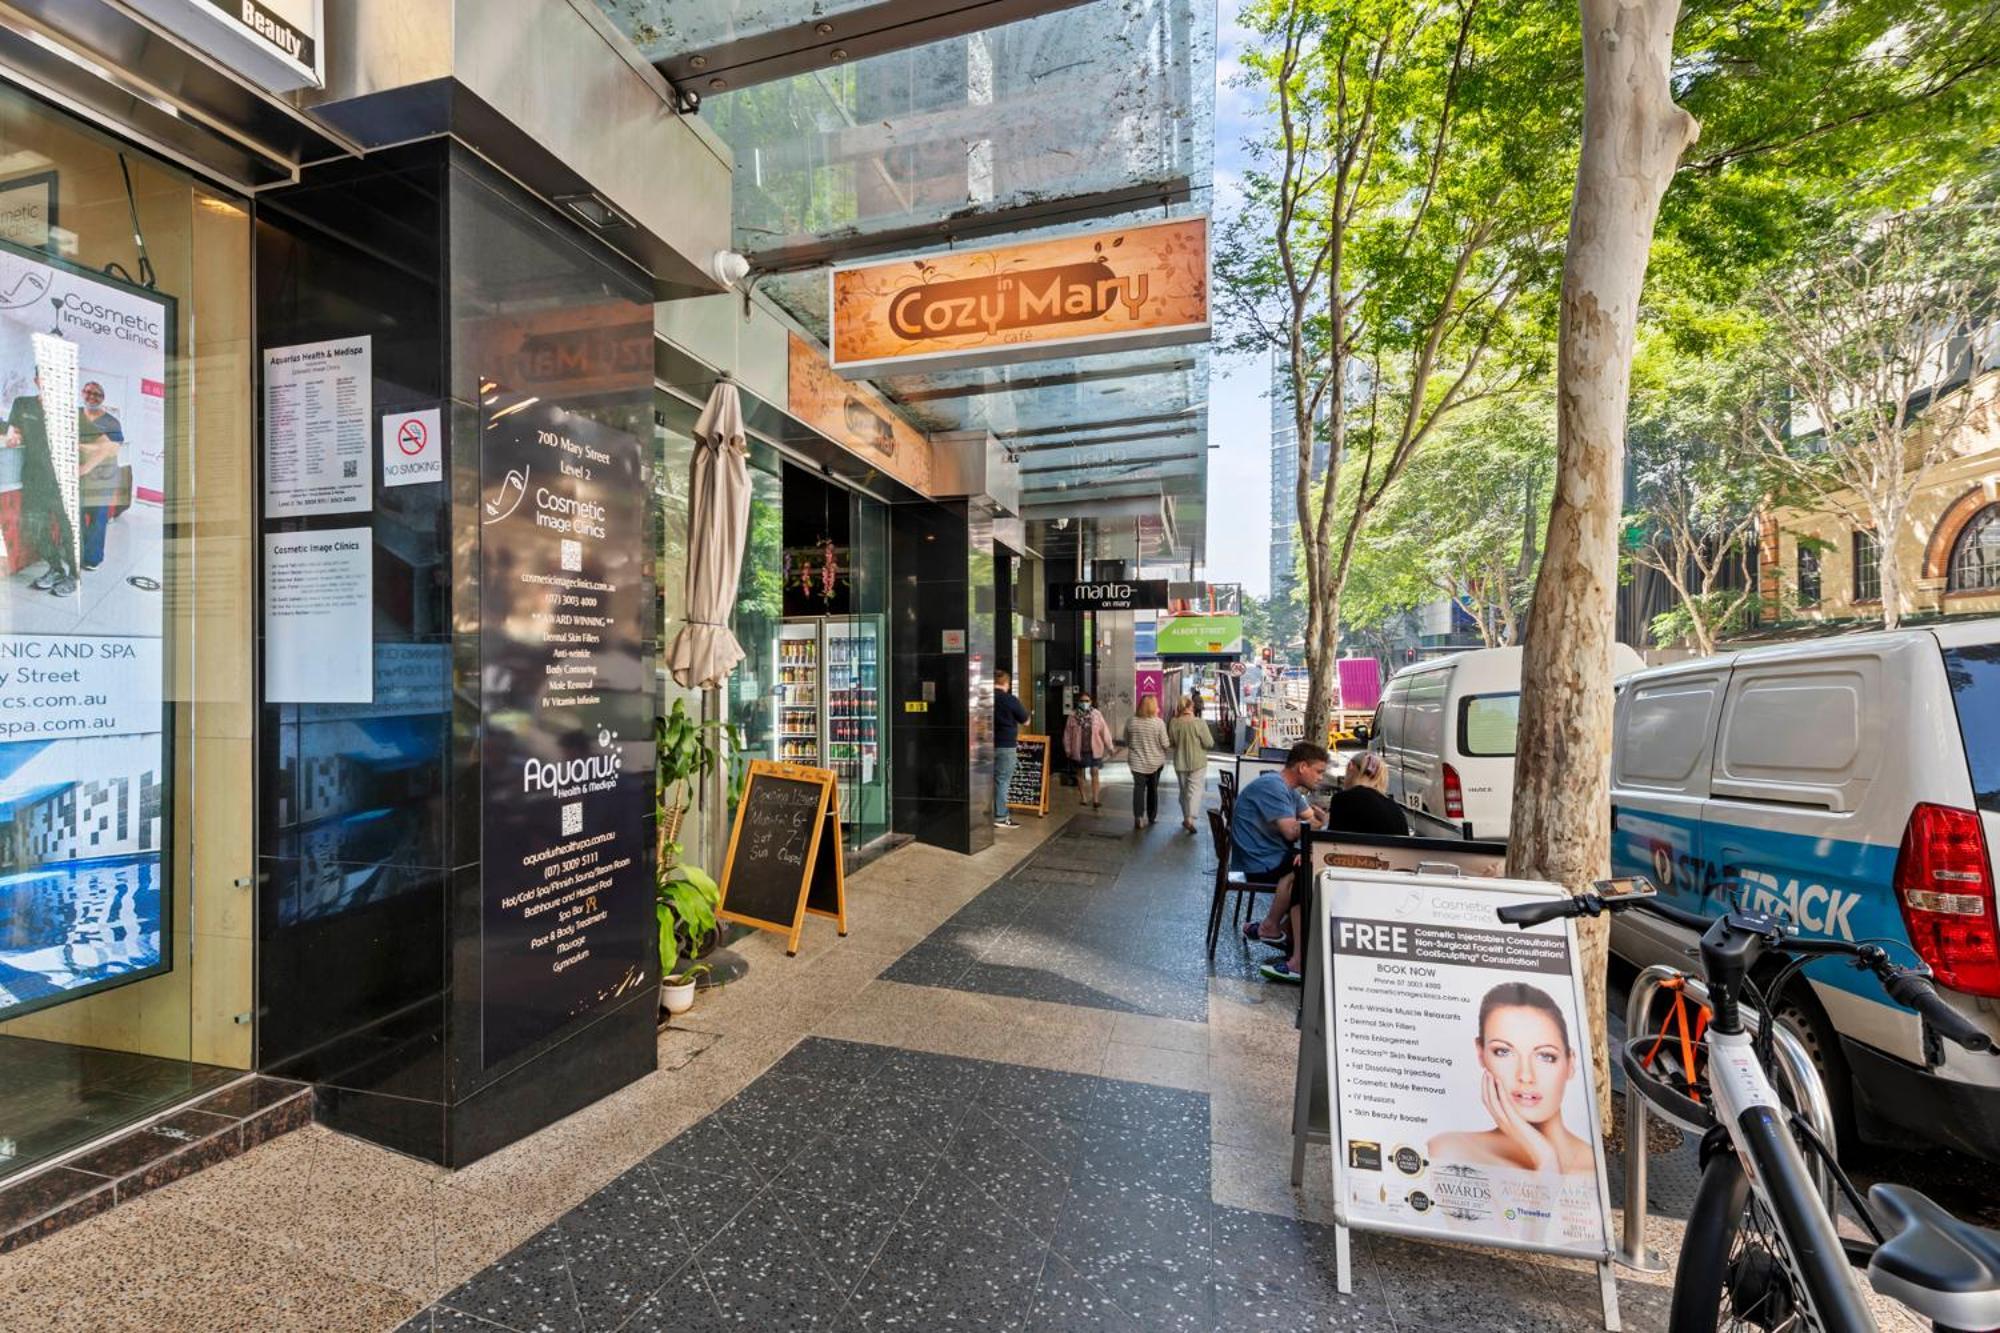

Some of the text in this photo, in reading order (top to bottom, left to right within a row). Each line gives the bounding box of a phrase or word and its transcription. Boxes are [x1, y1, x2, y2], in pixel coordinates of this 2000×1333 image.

[242, 0, 301, 60] Beauty
[895, 272, 1150, 337] Cozy in Mary
[63, 292, 159, 336] Cosmetic
[63, 311, 159, 350] Image Clinics
[302, 350, 326, 361] Health
[537, 430, 611, 465] 70D Mary Street
[385, 460, 441, 476] NO SMOKING
[560, 460, 591, 481] Level 2
[536, 487, 606, 522] Cosmetic
[536, 511, 606, 539] Image Clinics
[273, 541, 360, 555] Cosmetic Image Clinics
[1075, 584, 1138, 600] mantra
[1113, 600, 1131, 608] mary
[543, 614, 573, 625] AWARD
[573, 615, 606, 628] WINNING
[567, 631, 582, 643] Skin
[48, 643, 94, 659] AND
[100, 644, 136, 659] SPA
[16, 667, 81, 684] Street
[546, 665, 563, 677] Body
[524, 754, 616, 797] Aquarius
[558, 785, 581, 799] Health
[1409, 795, 1420, 809] 18
[544, 864, 561, 880] (07)
[582, 851, 599, 867] 5111
[613, 857, 632, 869] Room
[562, 892, 576, 905] and
[599, 877, 613, 890] Pool
[558, 904, 585, 922] Spa Bar
[1431, 897, 1492, 914] Cosmetic
[530, 935, 549, 950] Face
[556, 924, 576, 940] Body
[1340, 922, 1408, 954] FREE
[1414, 928, 1565, 949] Cosmetic Injectables Consultation!
[1415, 938, 1564, 960] Non-Surgical Facelift Consultation!
[1481, 954, 1540, 968] Consultation!
[1376, 963, 1437, 978] BOOK NOW
[1374, 977, 1396, 985] Phone
[1394, 1007, 1423, 1017] Muscle
[1350, 1017, 1416, 1031] Dermal Skin Fillers
[1350, 1032, 1420, 1046] Penis Enlargement
[1389, 1051, 1406, 1060] Skin
[1407, 1053, 1453, 1067] Resurfacing
[1364, 1063, 1403, 1076] Dissolving
[1403, 1067, 1441, 1079] Injections
[1352, 1078, 1446, 1095] Cosmetic Mole Removal
[1363, 1093, 1396, 1104] Infusions
[1353, 1108, 1428, 1123] Skin Beauty Booster
[1434, 1183, 1492, 1200] AWARDS
